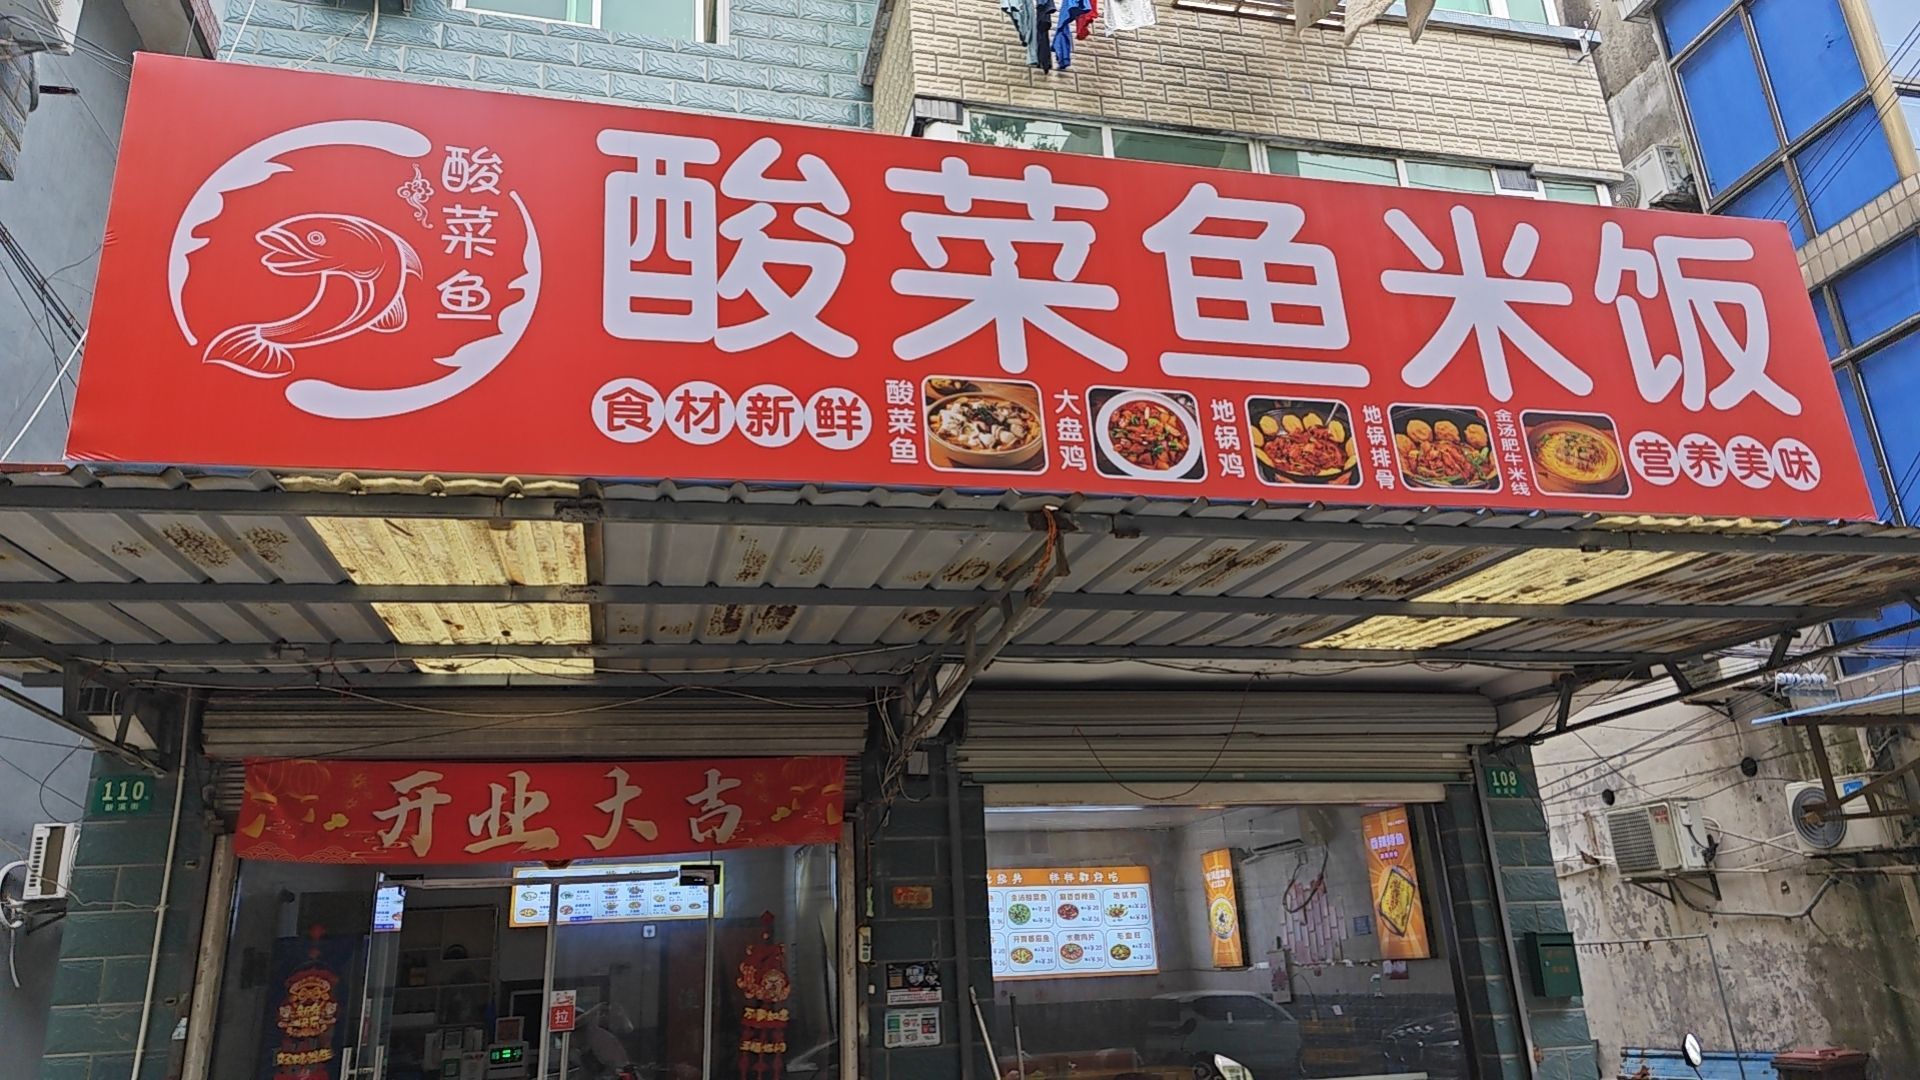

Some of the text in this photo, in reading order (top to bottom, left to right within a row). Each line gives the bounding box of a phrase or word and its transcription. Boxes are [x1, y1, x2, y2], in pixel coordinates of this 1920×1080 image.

[436, 145, 503, 321] 酸菜鱼
[597, 129, 1803, 416] 酸菜鱼米饭
[601, 384, 864, 440] 食材新鲜
[885, 379, 919, 465] 酸菜鱼
[1053, 389, 1088, 472] 大盘鸡
[1210, 398, 1246, 479] 地锅鸡
[1362, 404, 1396, 491] 地锅排骨
[1493, 408, 1532, 497] 金汤肥牛米线
[1636, 437, 1819, 485] 营养美味
[102, 781, 145, 801] 110
[372, 765, 743, 858] 开业大吉
[1491, 770, 1517, 787] 108
[555, 1009, 569, 1024] 拉
